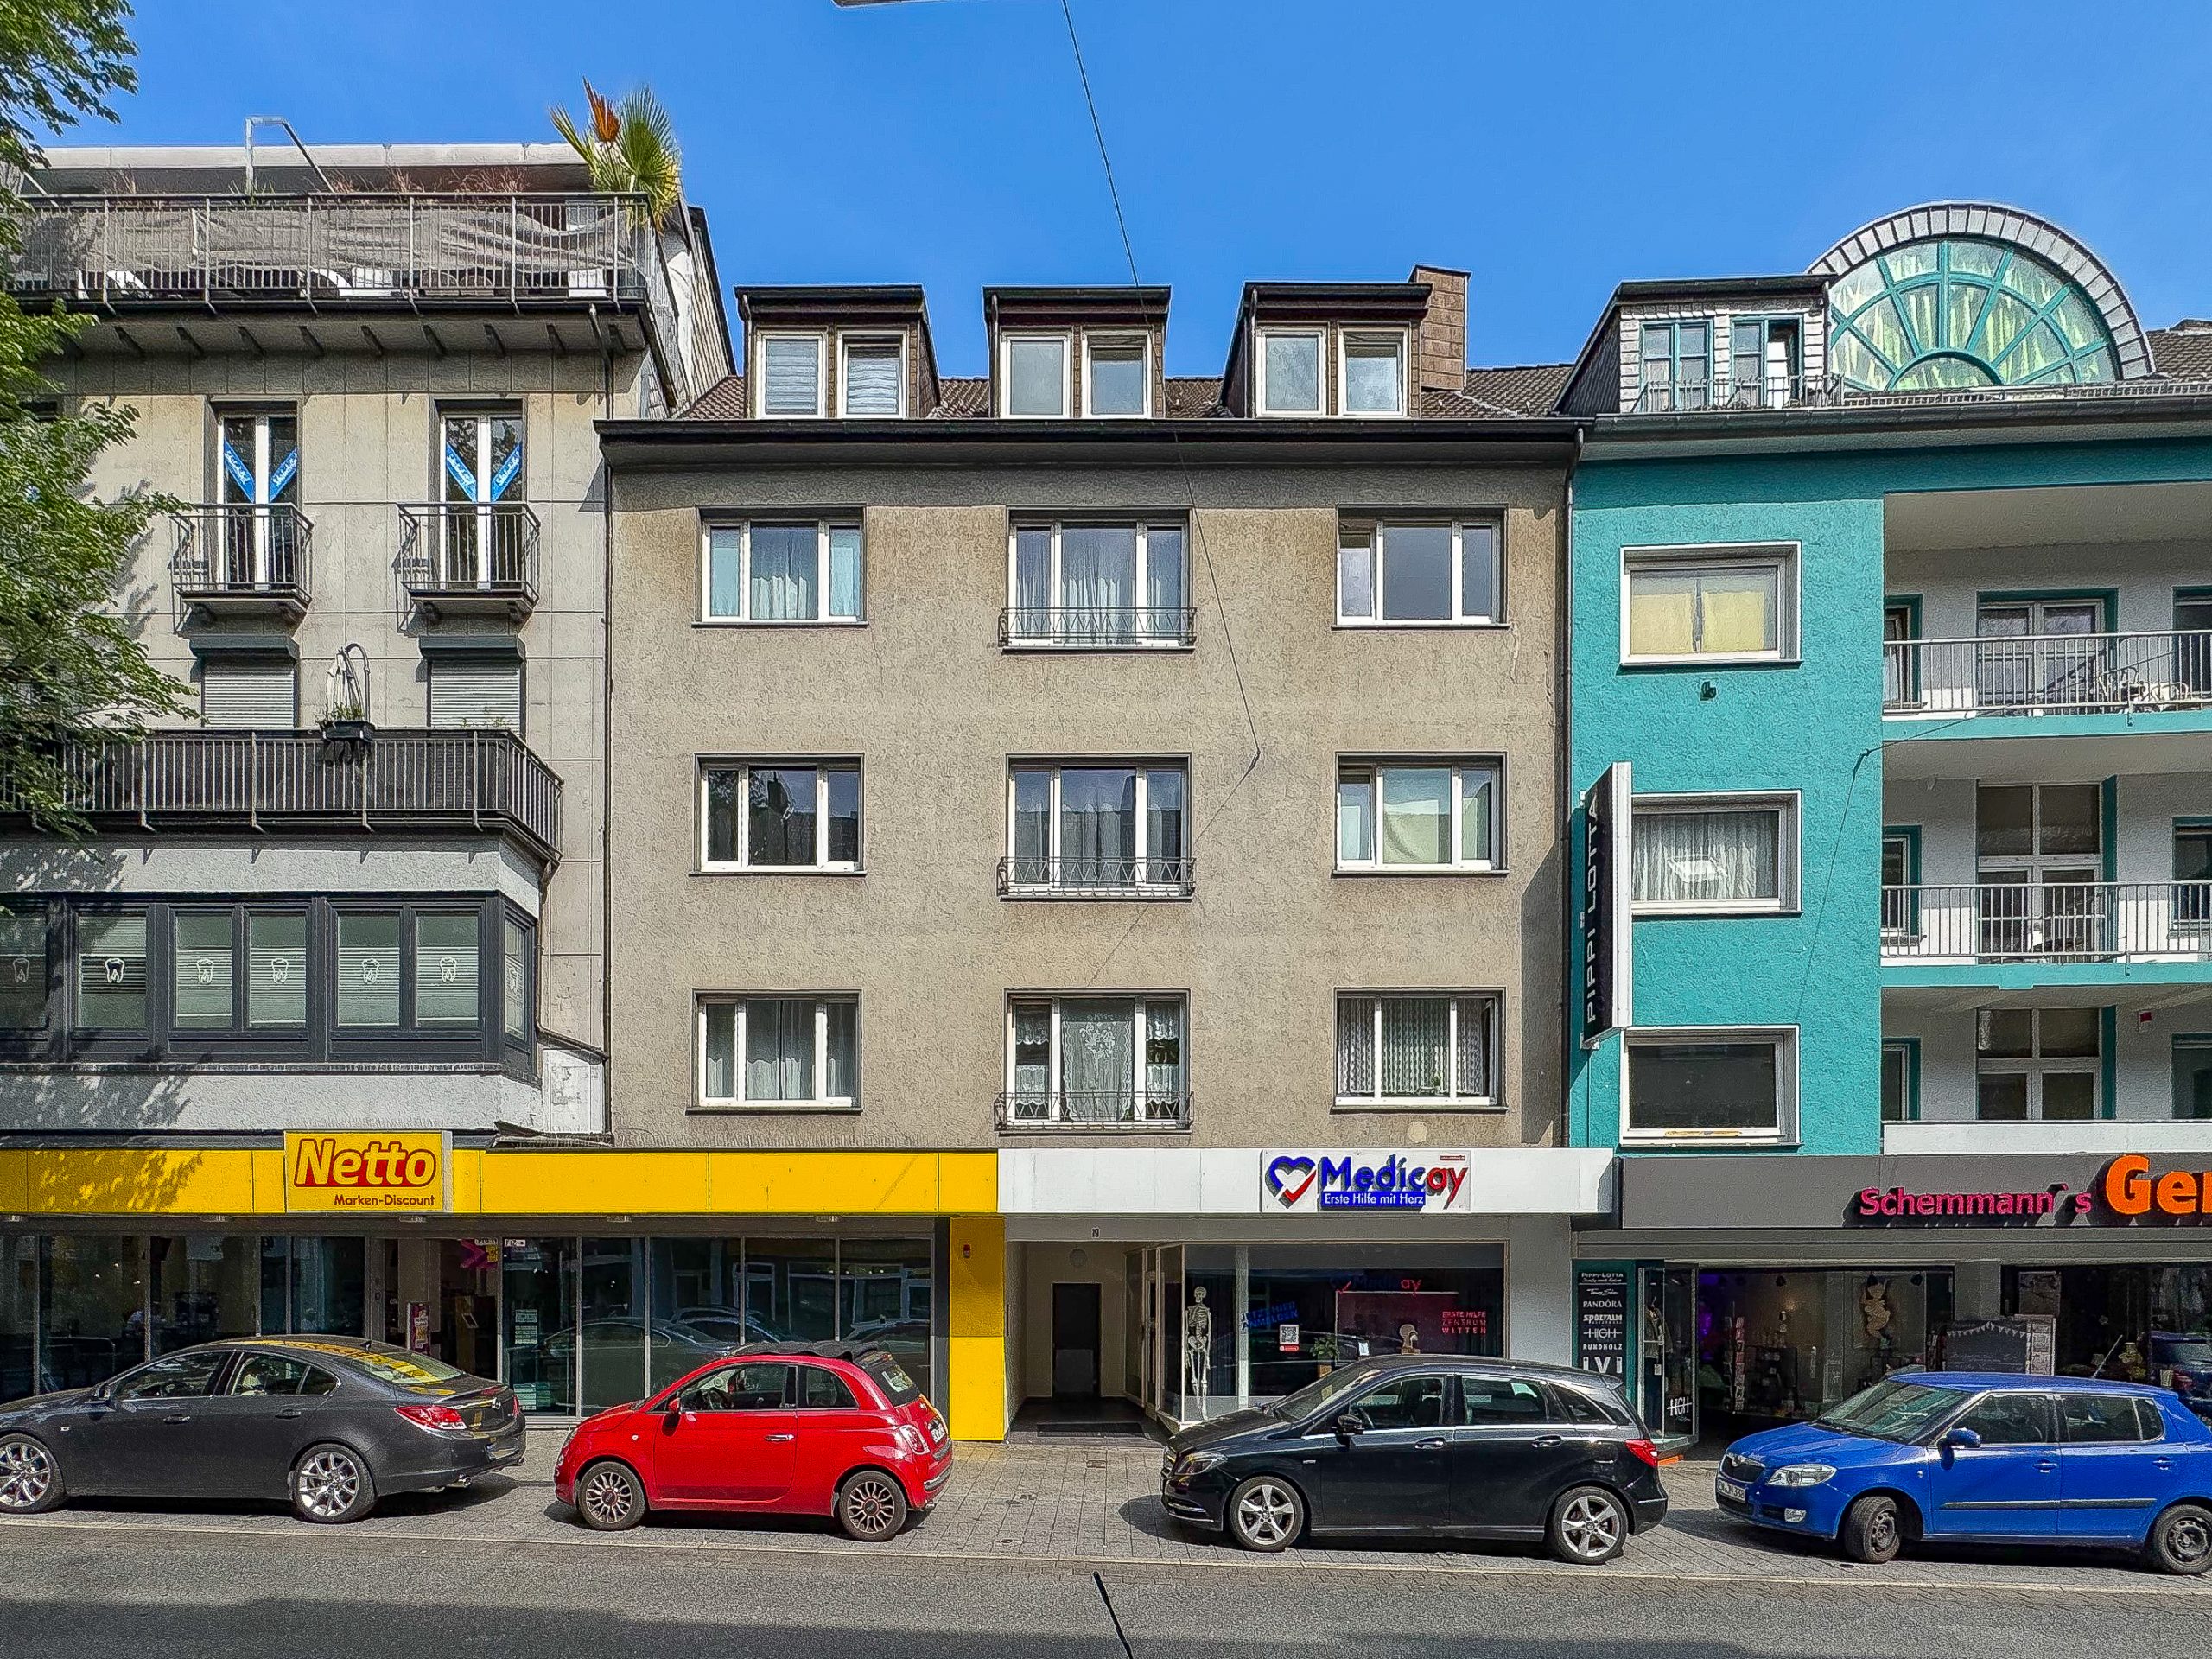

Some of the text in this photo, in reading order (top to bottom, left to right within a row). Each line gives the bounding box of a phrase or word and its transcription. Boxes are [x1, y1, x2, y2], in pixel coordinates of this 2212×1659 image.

[1586, 794, 1598, 1024] PIPPI LOTTA
[294, 1138, 437, 1187] Netto
[1319, 1154, 1469, 1204] Medicay
[334, 1194, 435, 1206] Marken-Discount
[1325, 1193, 1425, 1205] Erste Hilfe mit Herz
